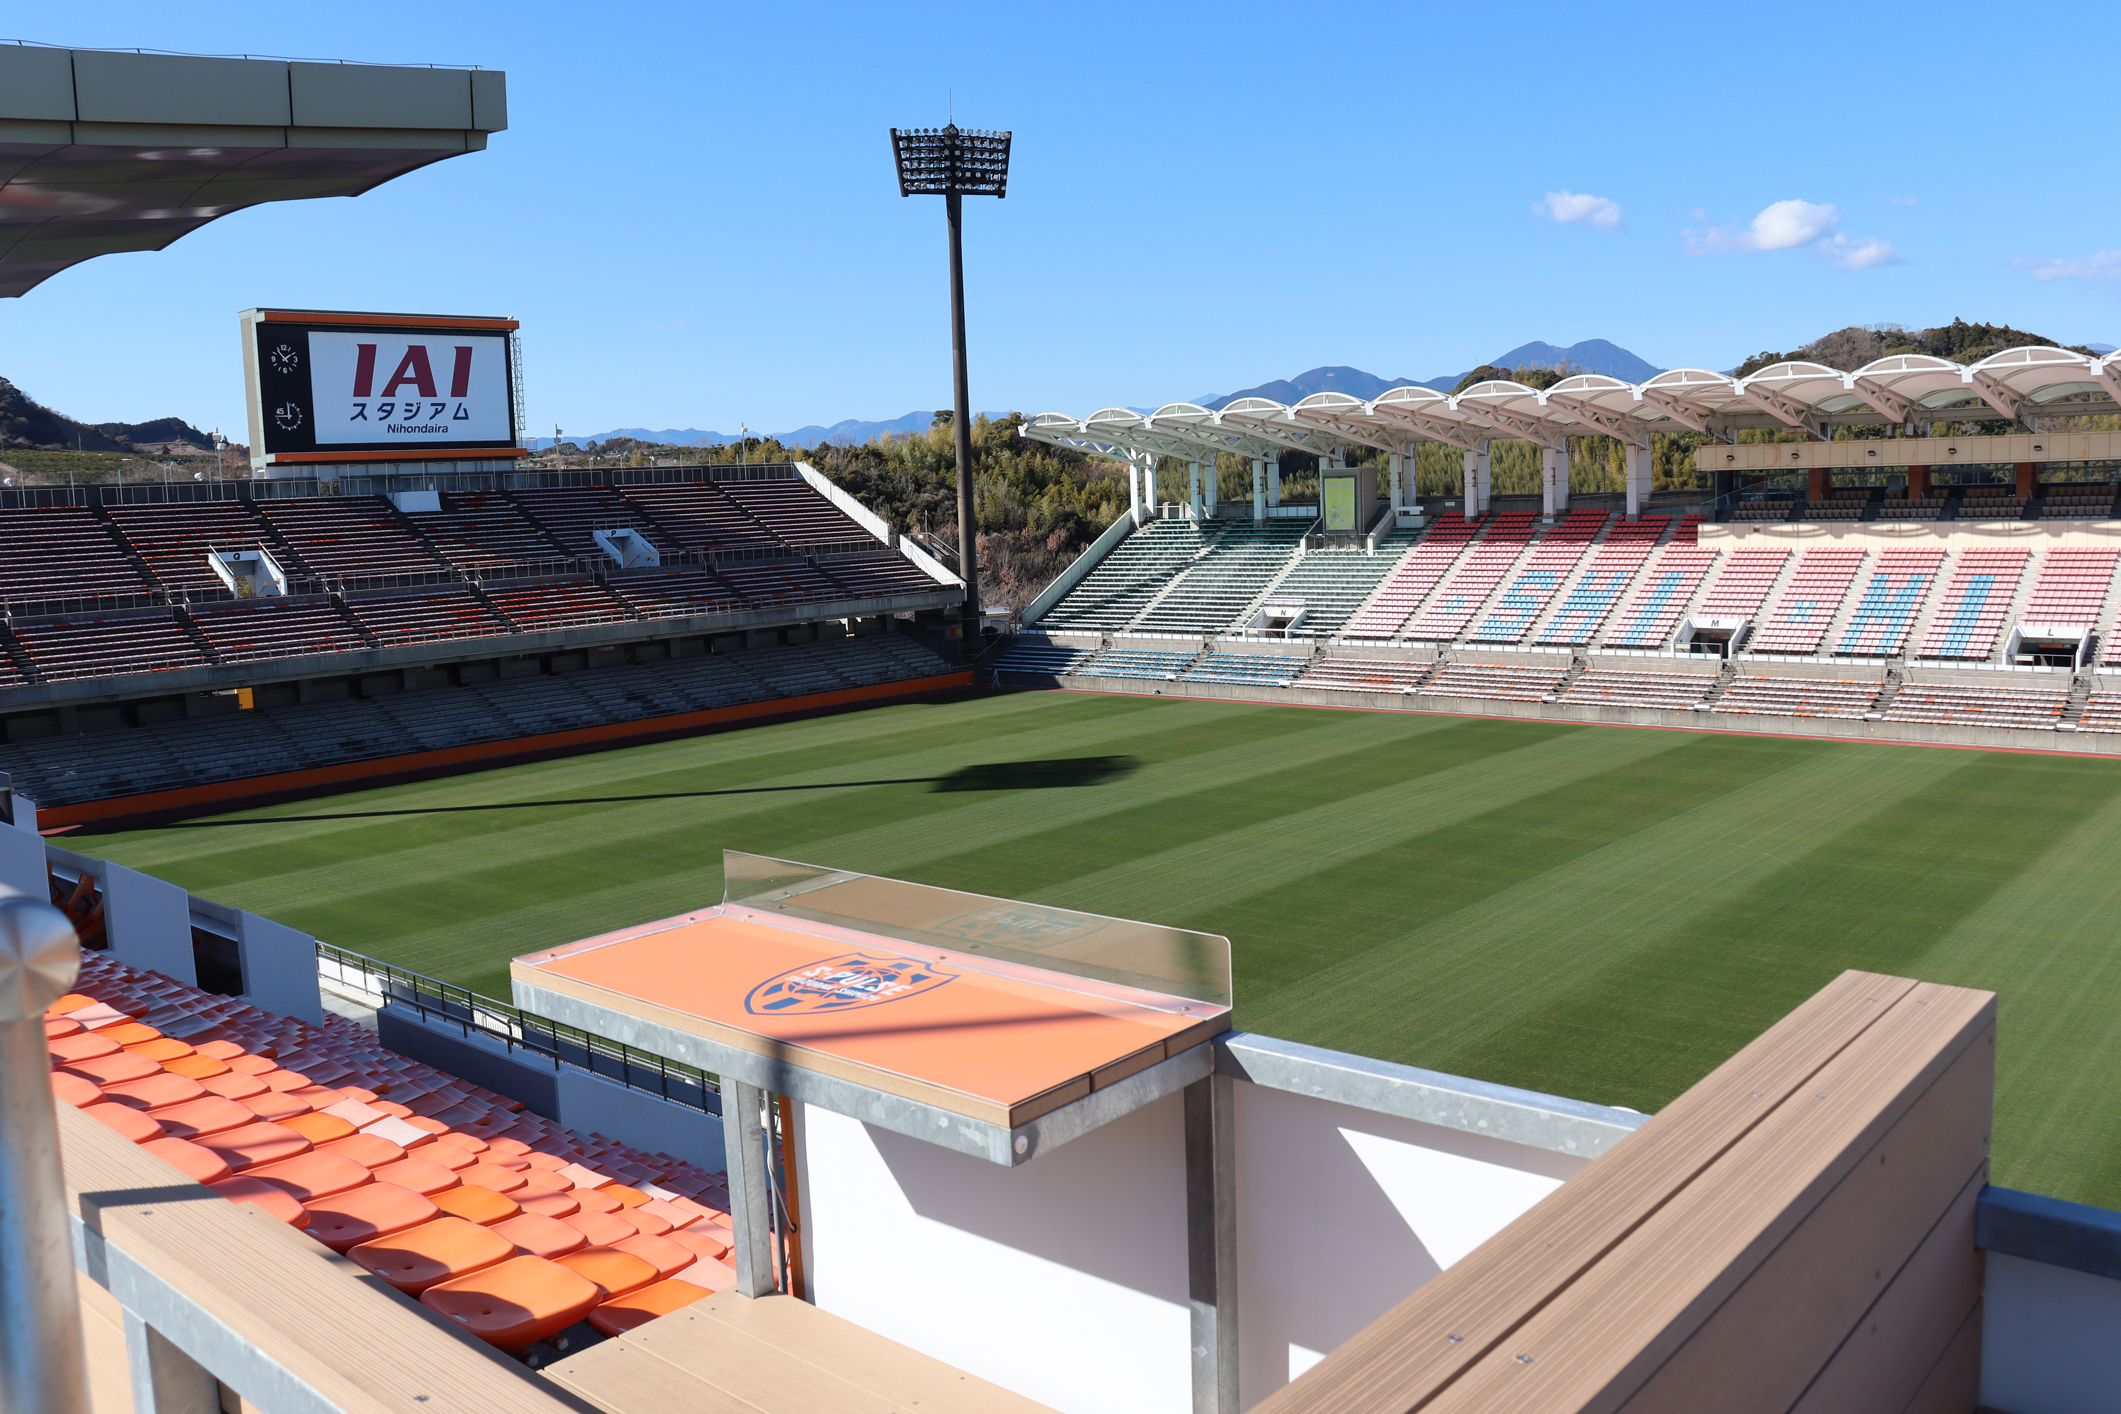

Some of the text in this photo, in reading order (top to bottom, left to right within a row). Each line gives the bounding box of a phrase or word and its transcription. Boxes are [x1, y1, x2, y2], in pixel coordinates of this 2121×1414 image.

[353, 343, 473, 398] IAI
[276, 407, 285, 415] 45
[350, 402, 470, 421] スタジアム
[387, 423, 449, 434] Nihondaira
[233, 552, 241, 560] Q
[1710, 619, 1720, 627] M
[2047, 628, 2054, 636] L
[801, 966, 912, 996] S-PULSE
